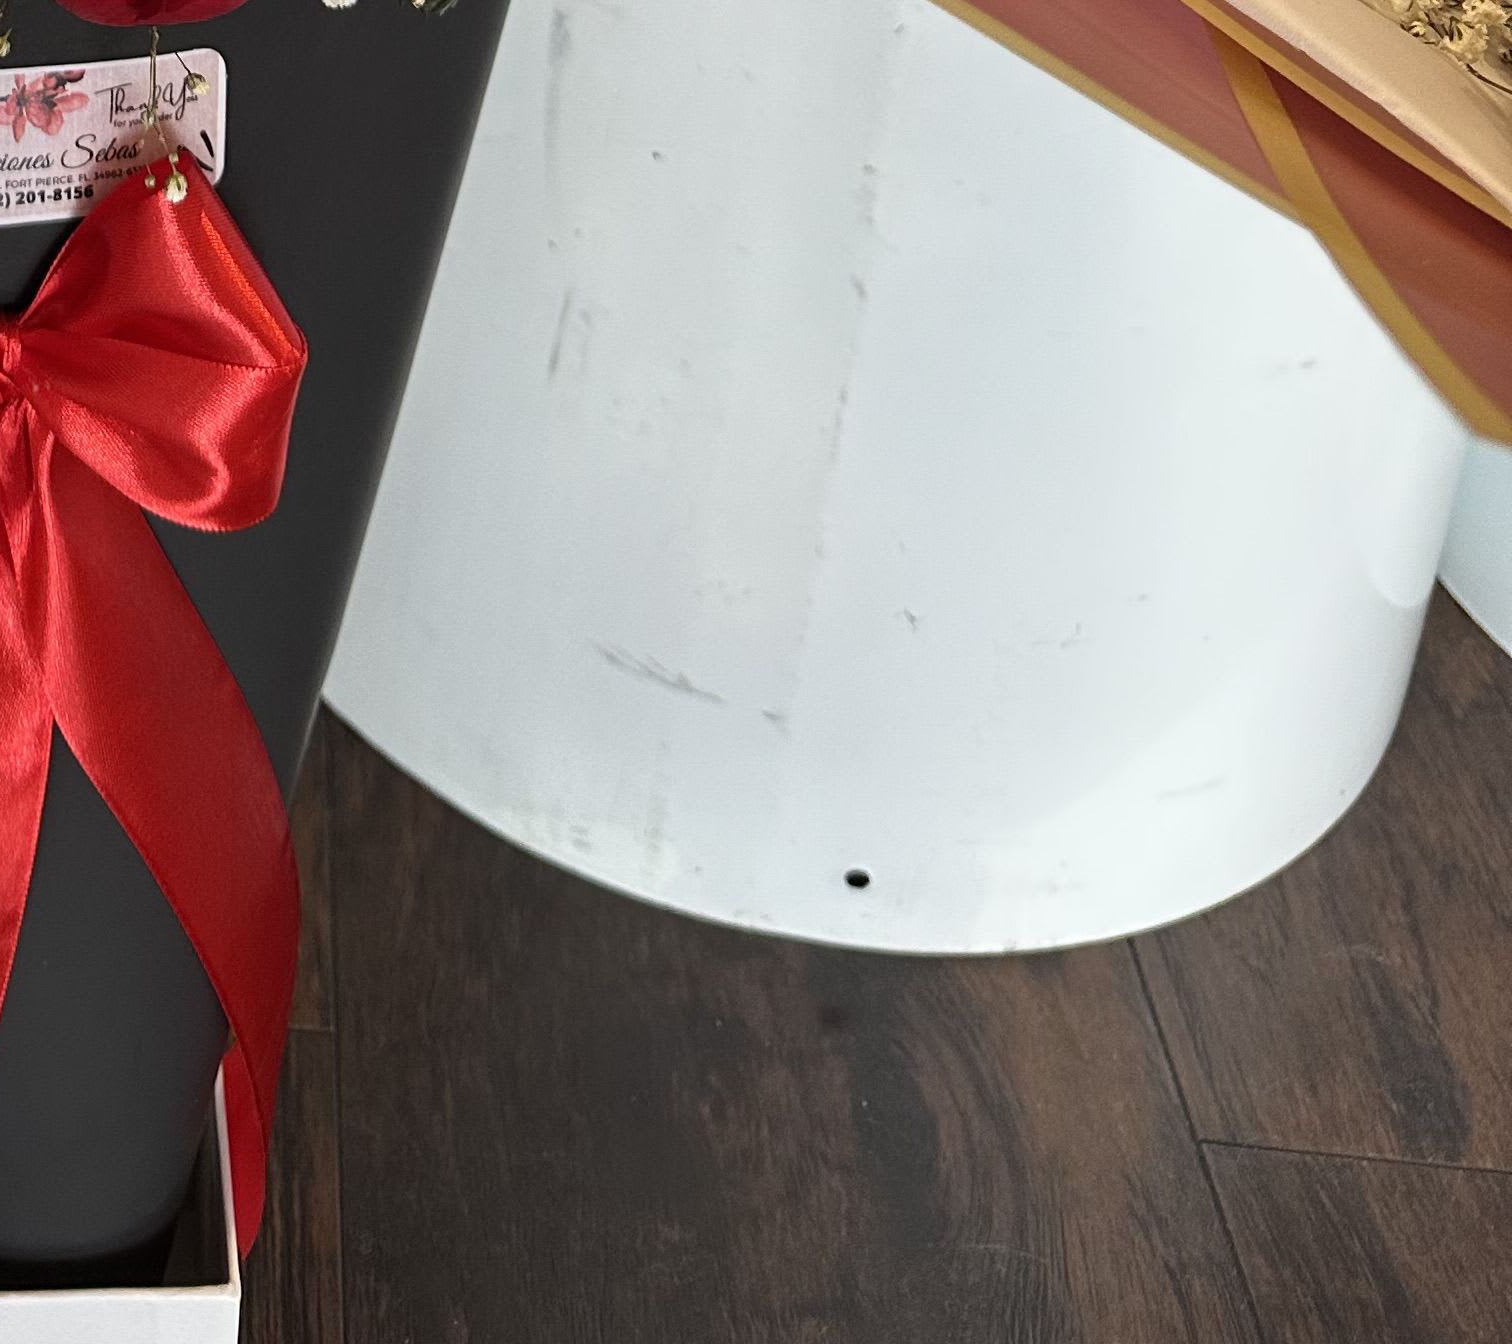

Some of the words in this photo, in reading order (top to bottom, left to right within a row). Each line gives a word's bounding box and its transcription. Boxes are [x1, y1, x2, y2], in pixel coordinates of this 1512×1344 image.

[61, 133, 139, 169] Sebas
[5, 178, 32, 189] FORT
[15, 184, 95, 206] 201-8156
